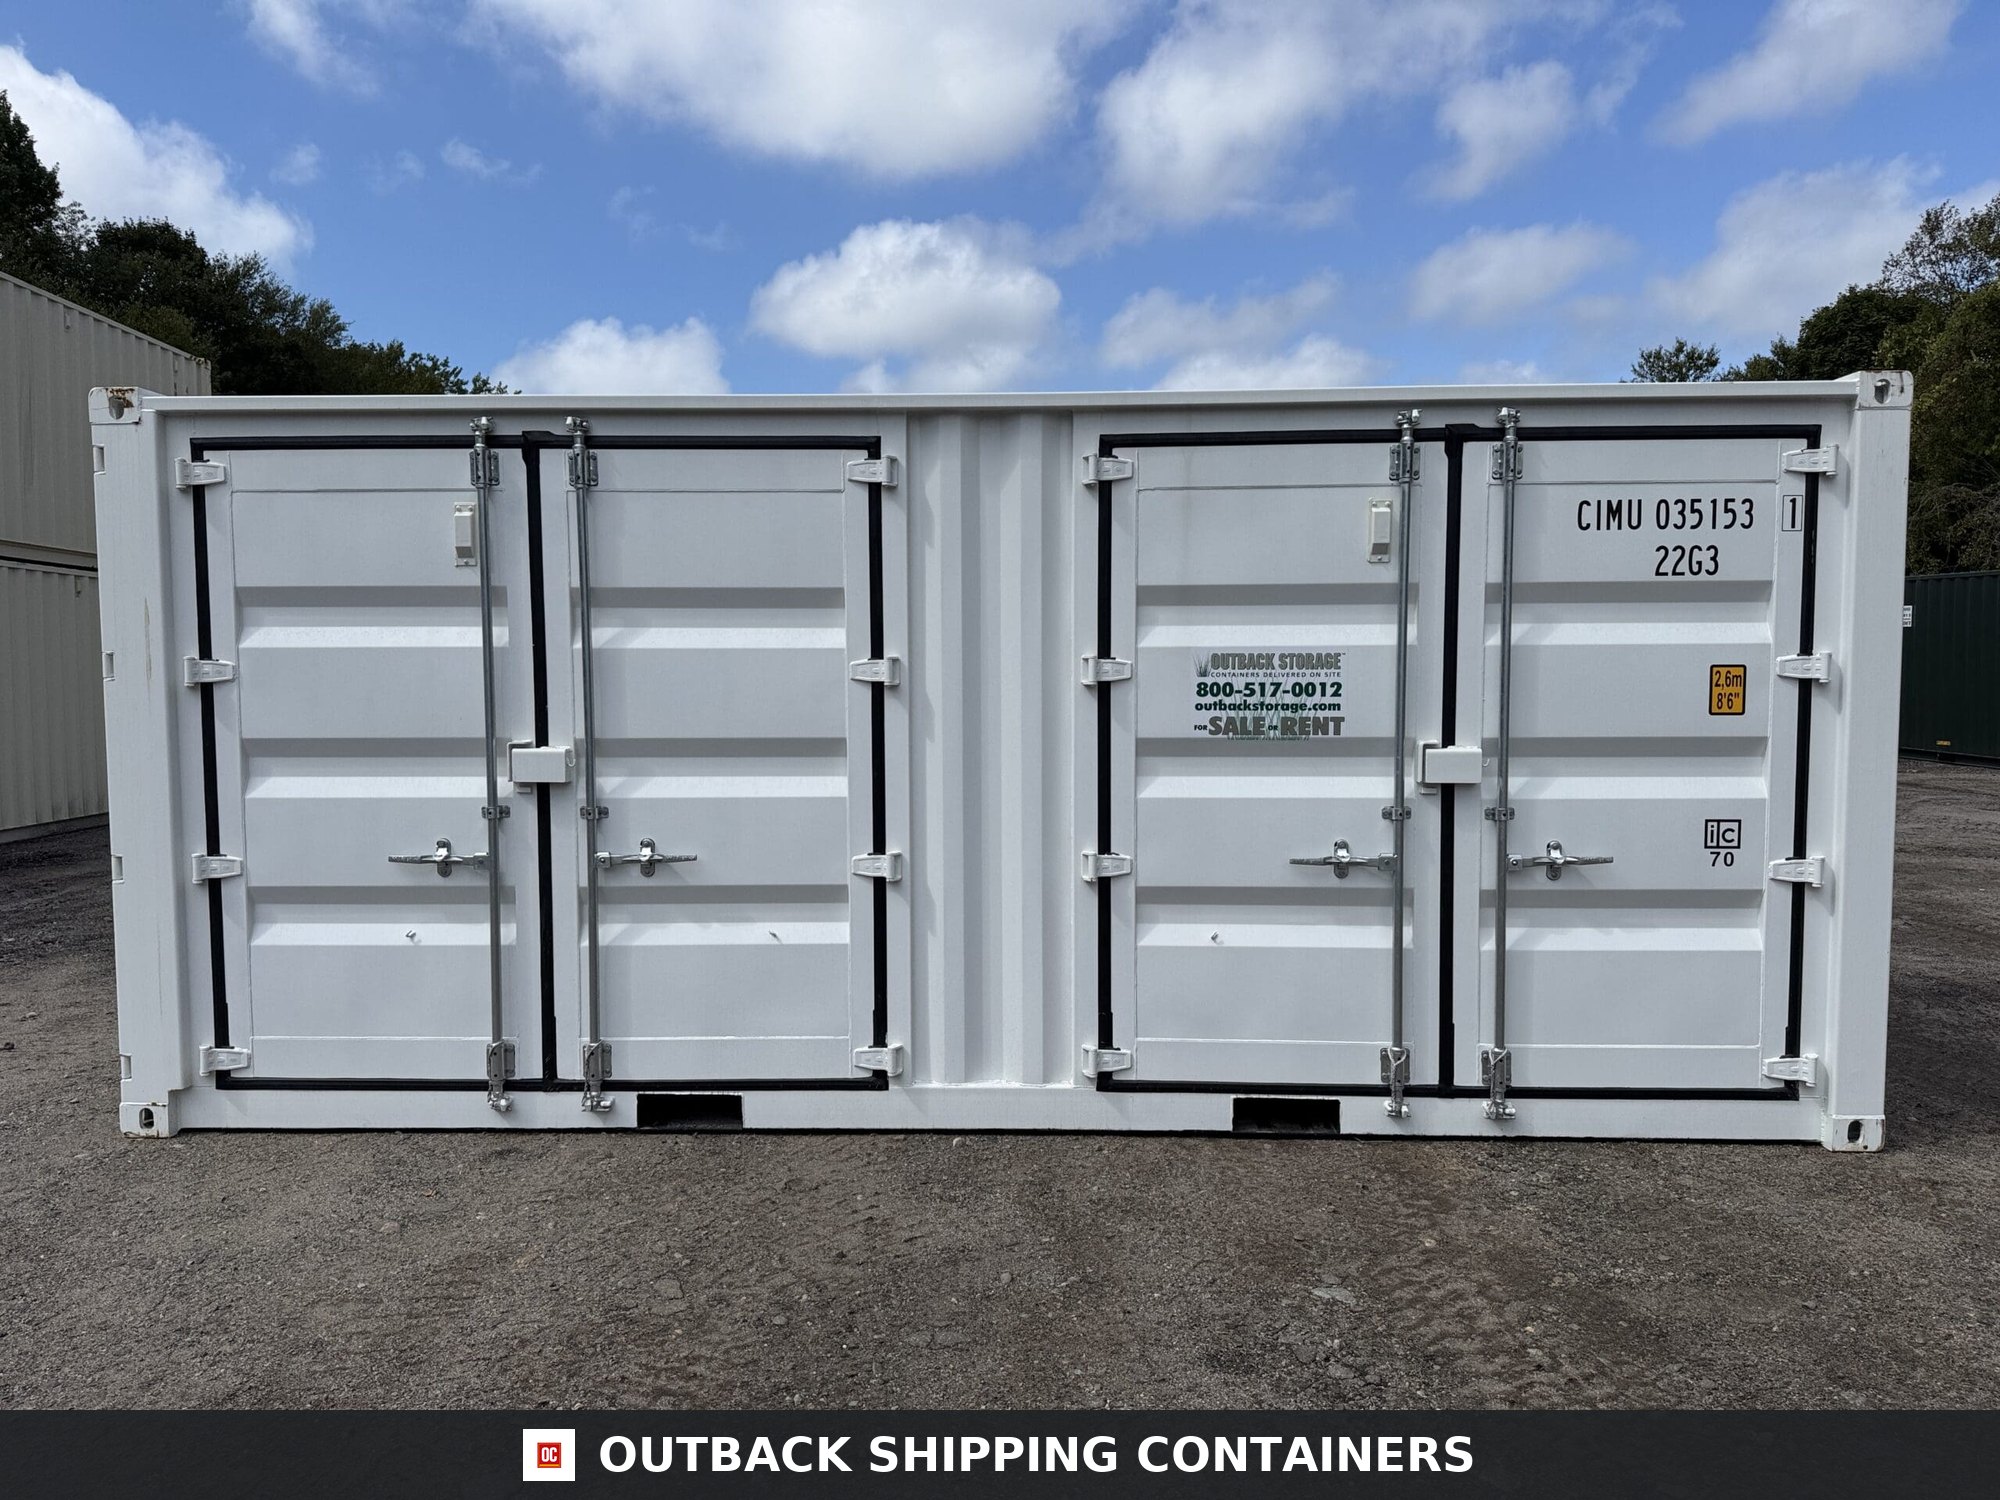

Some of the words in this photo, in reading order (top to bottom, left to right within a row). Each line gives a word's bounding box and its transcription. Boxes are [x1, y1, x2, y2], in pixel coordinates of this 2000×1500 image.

[1577, 499, 1642, 531] CIMU
[1656, 498, 1754, 530] 035153
[1789, 497, 1797, 529] 1
[1655, 545, 1719, 577] 22G3
[1210, 653, 1275, 670] OUTBACK
[1714, 670, 1742, 690] 2,6m
[1196, 682, 1343, 698] 800-517-0012
[1195, 700, 1341, 713] outbackstorage.com
[1717, 692, 1740, 710] 8'6"
[1209, 716, 1266, 736] SALE
[1281, 717, 1345, 736] RENT
[1709, 851, 1735, 867] 70
